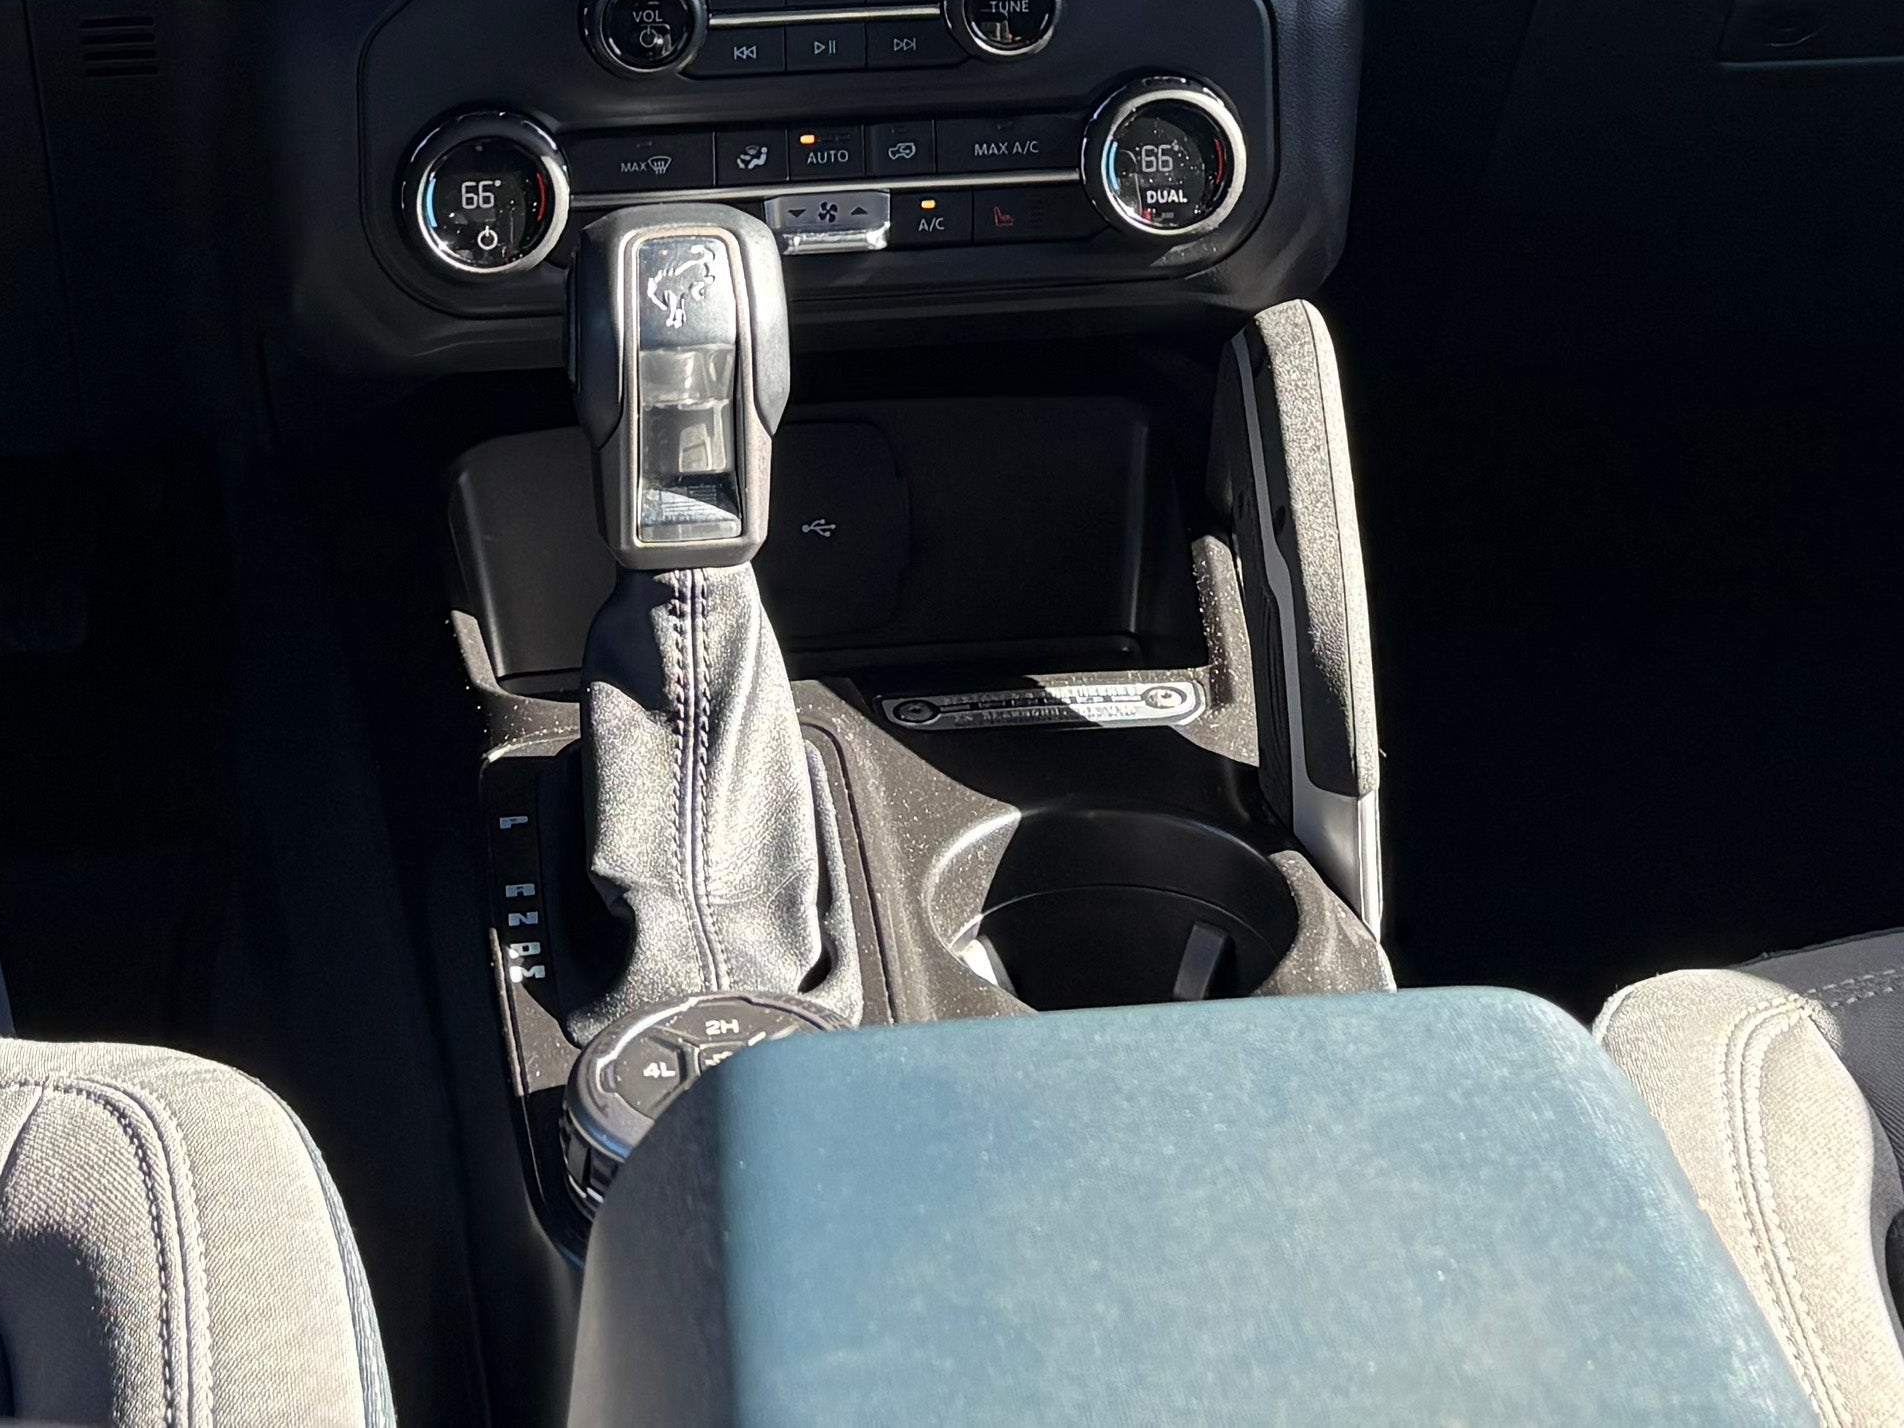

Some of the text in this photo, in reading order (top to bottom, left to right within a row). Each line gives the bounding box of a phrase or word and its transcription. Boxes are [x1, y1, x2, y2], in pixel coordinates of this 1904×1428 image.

[989, 0, 1030, 14] TUNE
[631, 9, 663, 24] VOL
[806, 149, 850, 164] AUTO
[974, 140, 1040, 157] MAX A/C
[620, 160, 646, 173] MAX
[1146, 189, 1188, 205] DUAL
[918, 216, 945, 232] A/C
[508, 911, 538, 927] N
[705, 1018, 740, 1036] 2H
[643, 1061, 676, 1079] 4L
